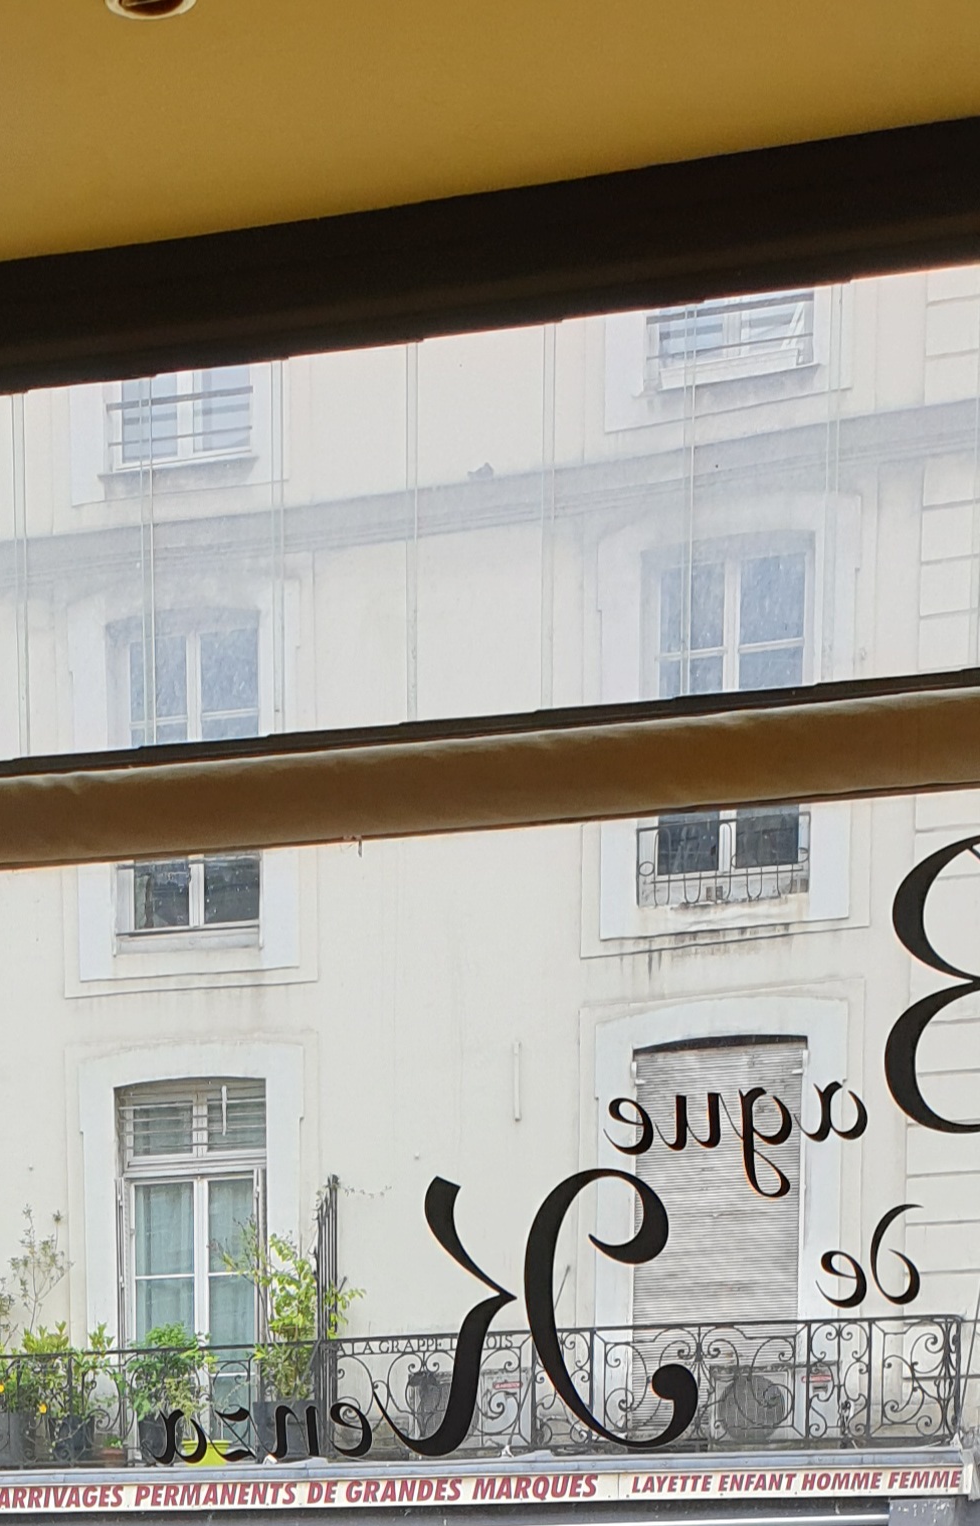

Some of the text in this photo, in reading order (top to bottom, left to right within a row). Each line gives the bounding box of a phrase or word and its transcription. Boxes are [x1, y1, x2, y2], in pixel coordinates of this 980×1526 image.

[134, 1482, 297, 1507] PERMANENTS
[307, 1480, 338, 1504] DE
[345, 1478, 463, 1503] GRANDES
[472, 1474, 599, 1501] MARQUES
[631, 1470, 962, 1493] LAYETTE ENFANT HOMME FEMME
